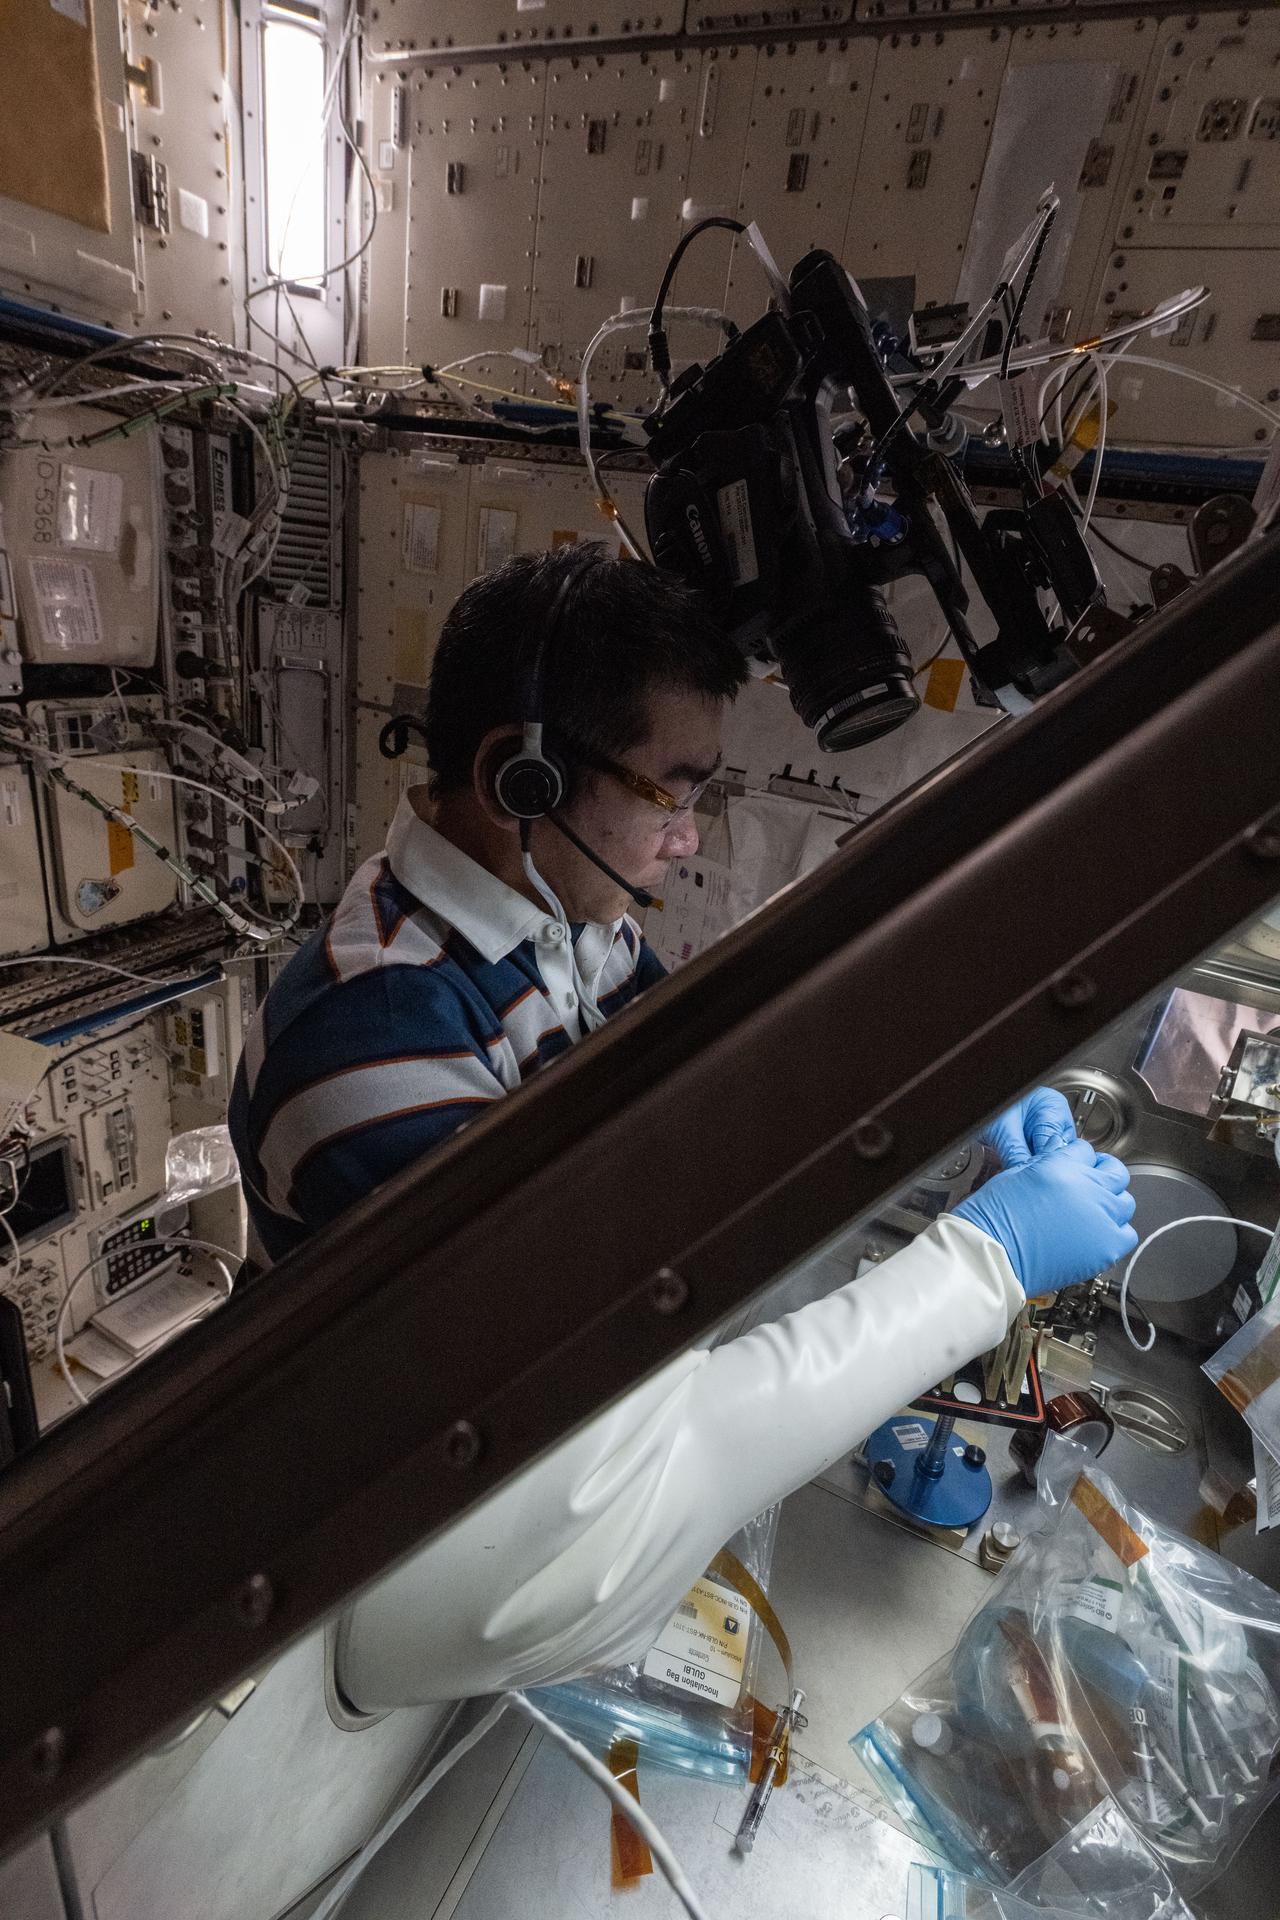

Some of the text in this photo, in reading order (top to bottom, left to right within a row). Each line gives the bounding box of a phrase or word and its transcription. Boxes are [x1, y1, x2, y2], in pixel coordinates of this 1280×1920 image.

[686, 504, 713, 565] Canon
[688, 1648, 709, 1662] Contents
[666, 1668, 719, 1698] Inoculation Bag
[682, 1664, 706, 1680] GULBI
